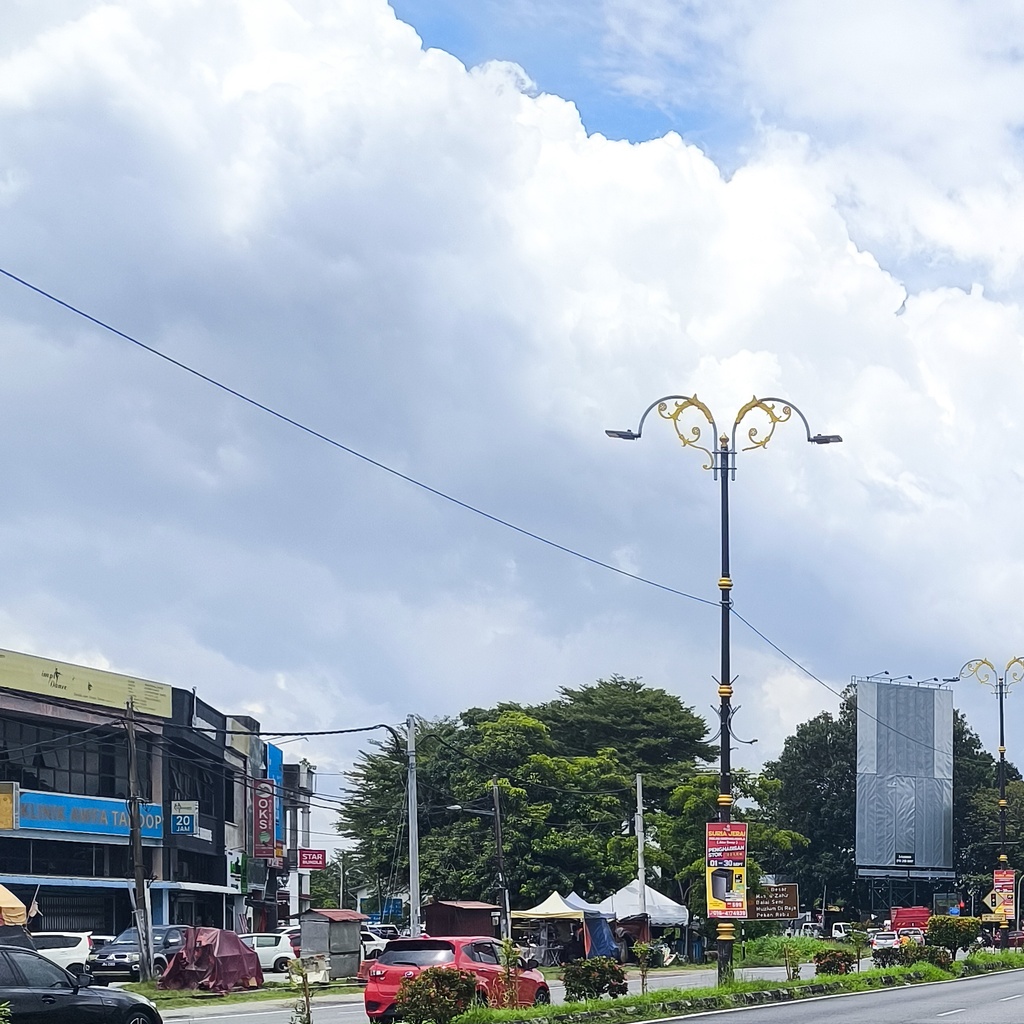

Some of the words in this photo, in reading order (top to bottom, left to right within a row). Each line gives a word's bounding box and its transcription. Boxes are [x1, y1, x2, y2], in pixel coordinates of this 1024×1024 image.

[258, 798, 269, 830] OKS
[176, 815, 190, 826] 20
[723, 859, 733, 867] 30
